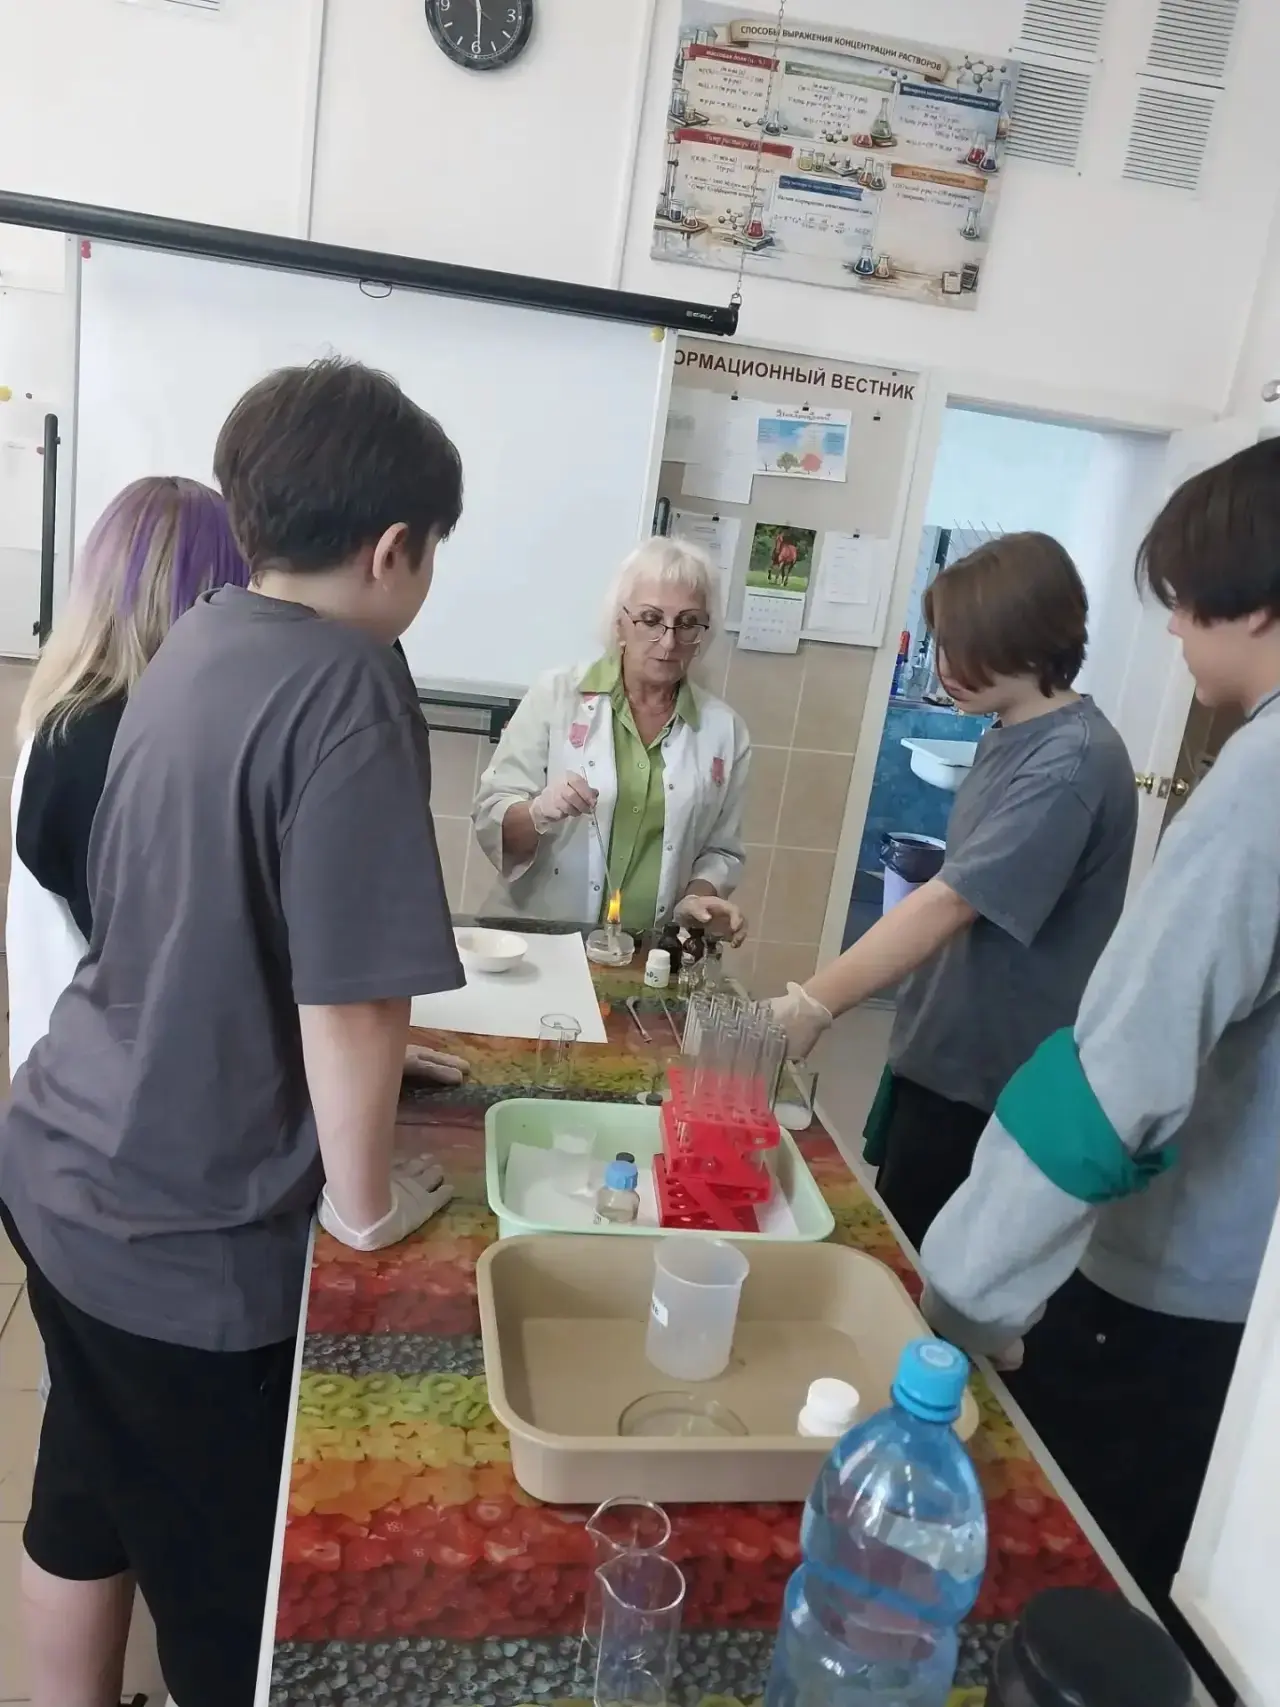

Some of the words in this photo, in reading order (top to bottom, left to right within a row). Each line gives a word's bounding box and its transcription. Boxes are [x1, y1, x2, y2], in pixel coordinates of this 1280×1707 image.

[506, 9, 516, 22] 3
[471, 41, 481, 54] 6
[782, 29, 833, 44] ВЫРАЖЕНИЯ
[834, 37, 897, 57] КОНЦЕНТРАЦИИ
[898, 51, 942, 70] РАСТВОРОВ
[674, 350, 826, 386] ОРМАЦИОННЫЙ
[831, 373, 917, 400] ВЕСТНИК
